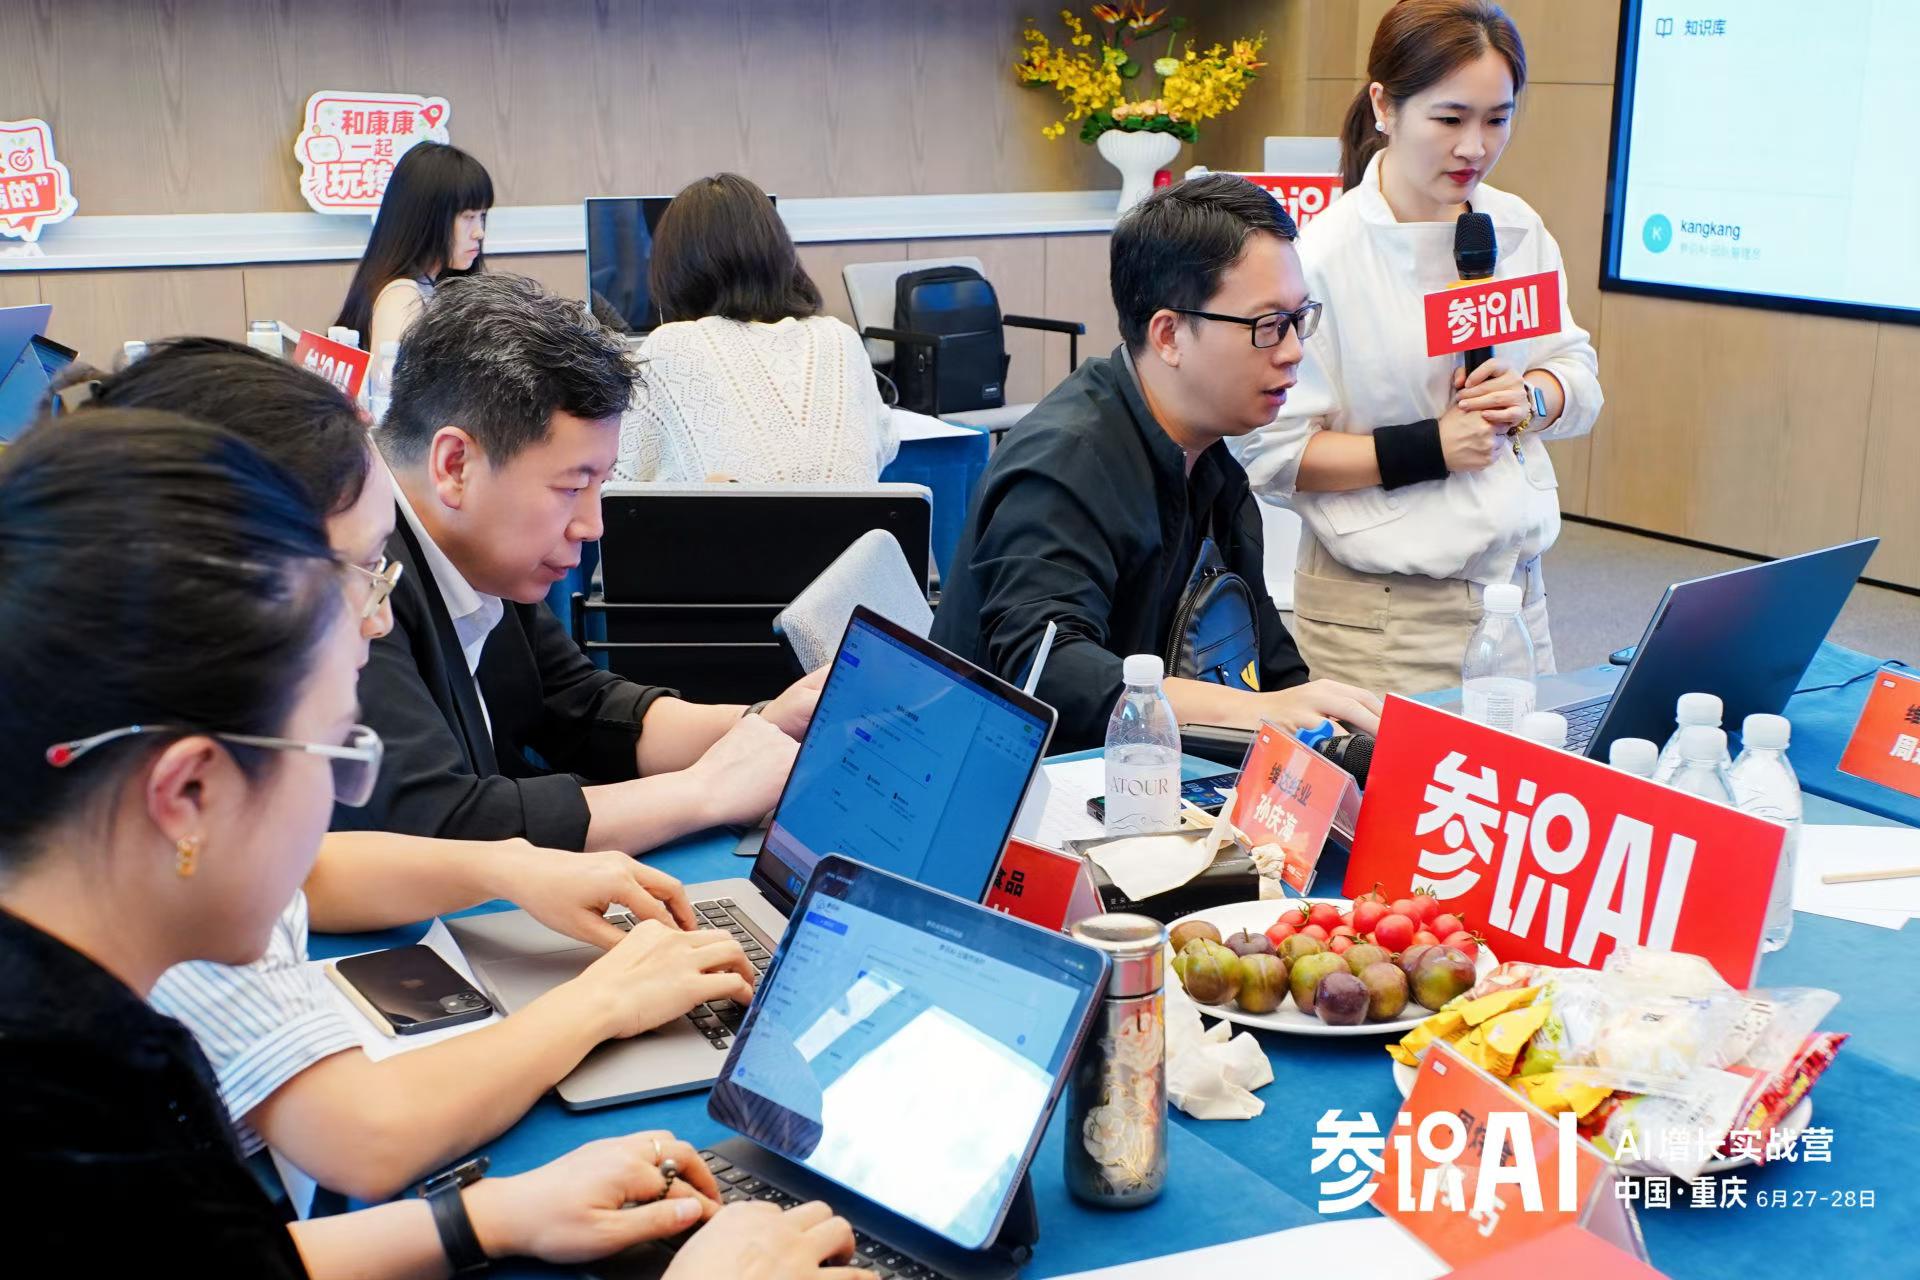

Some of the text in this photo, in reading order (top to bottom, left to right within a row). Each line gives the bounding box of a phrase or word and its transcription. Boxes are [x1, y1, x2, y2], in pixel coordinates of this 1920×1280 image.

[1684, 18, 1726, 36] 知识库
[342, 110, 415, 135] 和康康
[351, 138, 393, 157] 一起
[1652, 226, 1662, 241] K
[1680, 219, 1741, 240] kangkang
[1447, 285, 1540, 345] 参识AI
[1889, 732, 1920, 766] 周
[1111, 776, 1169, 796] ATOUR
[1410, 750, 1697, 967] 参识AI
